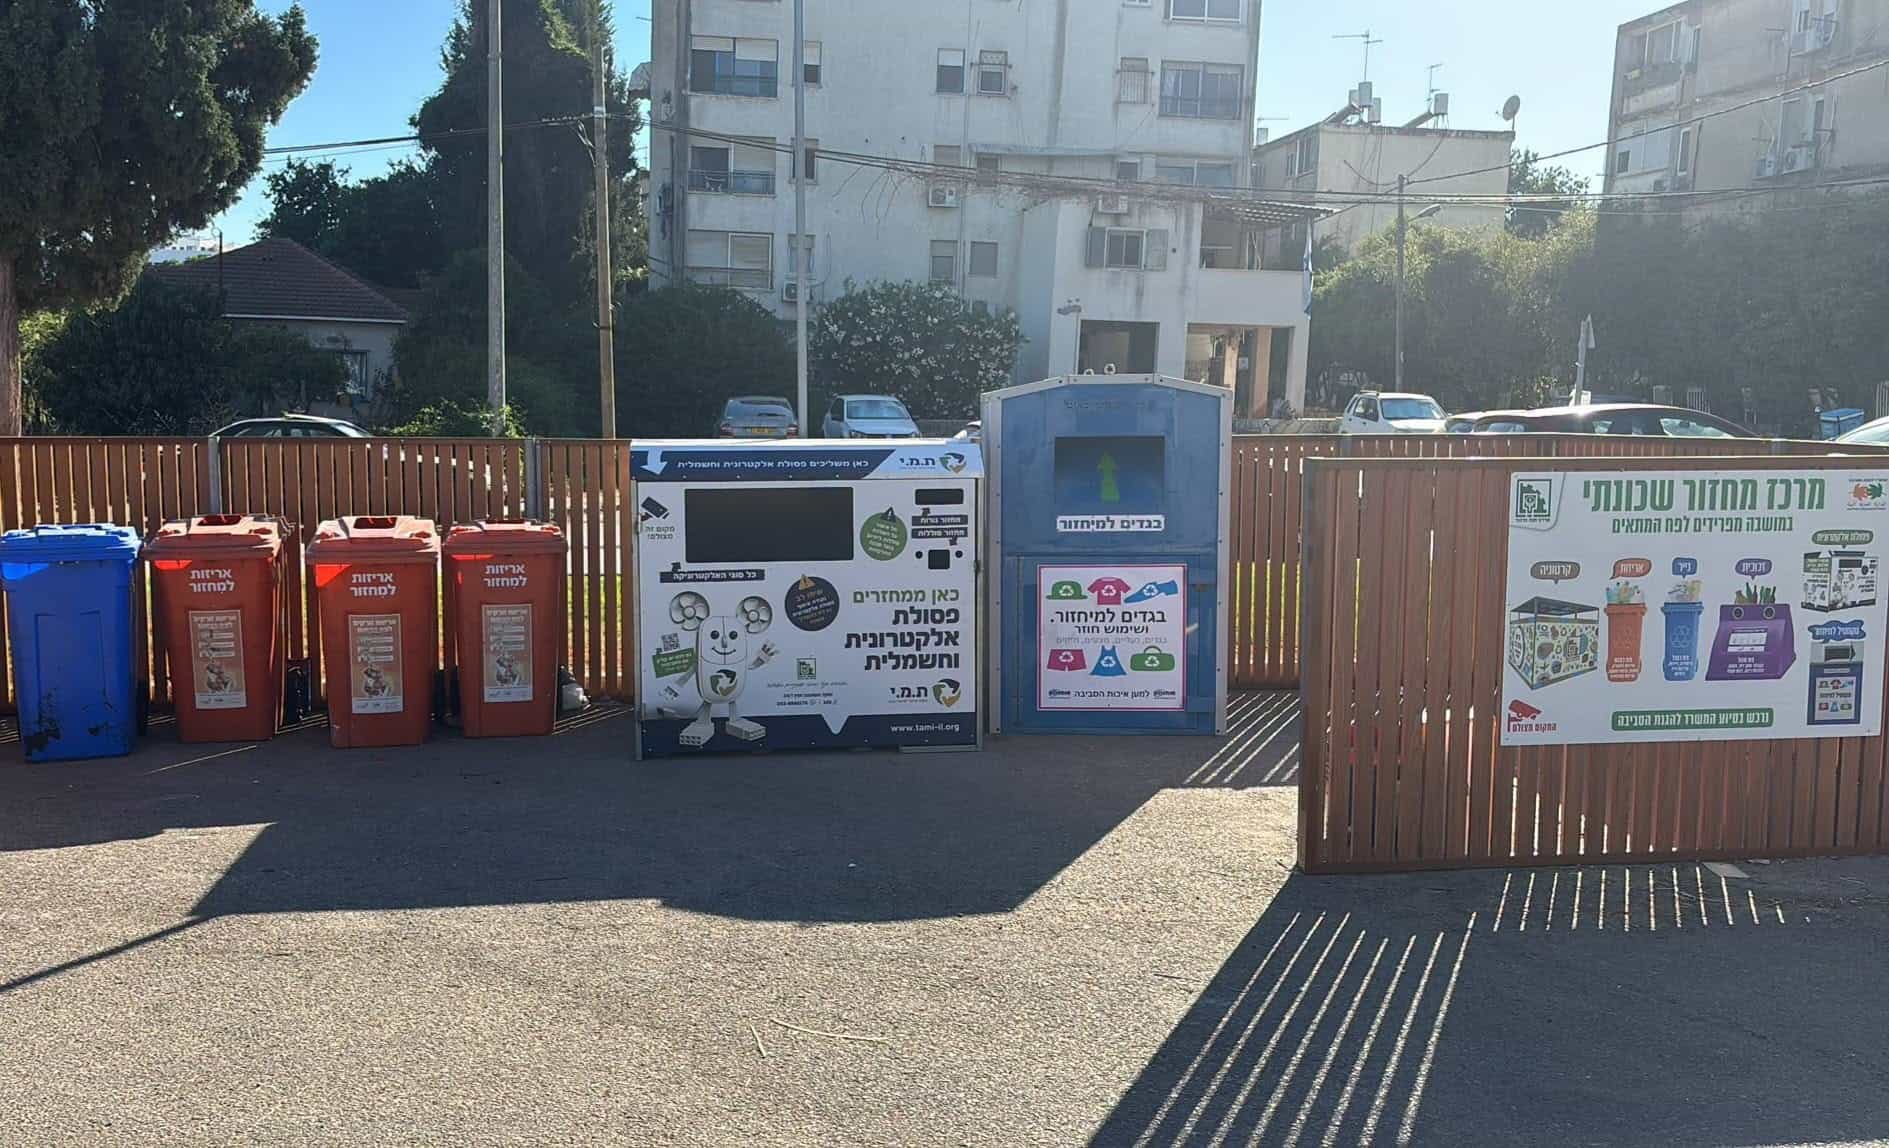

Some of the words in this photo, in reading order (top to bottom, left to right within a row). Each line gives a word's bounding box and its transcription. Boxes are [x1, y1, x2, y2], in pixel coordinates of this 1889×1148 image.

[678, 460, 720, 469] וחשמלית
[723, 460, 774, 470] אלקטרונית
[778, 460, 807, 468] פסולת
[809, 460, 850, 468] משליכים
[852, 460, 869, 469] כאן
[1583, 479, 1675, 512] שכונתי
[1683, 478, 1759, 511] מחזור
[1766, 478, 1827, 510] מרכז
[1059, 516, 1115, 529] למיחזור
[1121, 519, 1162, 529] בגדים
[1612, 517, 1662, 534] המתאים
[1664, 515, 1691, 533] לפח
[1694, 517, 1743, 533] מפרידים
[1746, 516, 1793, 532] במושבה
[190, 568, 232, 579] אריזות
[485, 564, 526, 574] אריזות
[745, 570, 757, 578] כל
[351, 572, 393, 583] אריזות
[853, 589, 926, 603] ממחזרים
[932, 589, 959, 605] כאן
[892, 606, 960, 625] פסולת
[1050, 608, 1116, 623] למיחזור.
[1121, 611, 1167, 623] בגדים
[1074, 625, 1100, 634] חוזר
[1104, 625, 1149, 634] ושימוש
[845, 628, 960, 651] אלקטרונית
[864, 651, 960, 670] וחשמלית
[1074, 690, 1105, 698] הסביבה
[1107, 690, 1129, 698] איכות
[1131, 688, 1150, 699] למען
[1617, 714, 1651, 727] הסביבה
[1653, 712, 1682, 726] להגנת
[1684, 713, 1716, 725] המשרד
[1718, 712, 1744, 724] בסיוע
[1746, 712, 1769, 724] נרכש
[890, 723, 960, 733] www.tami-il.org
